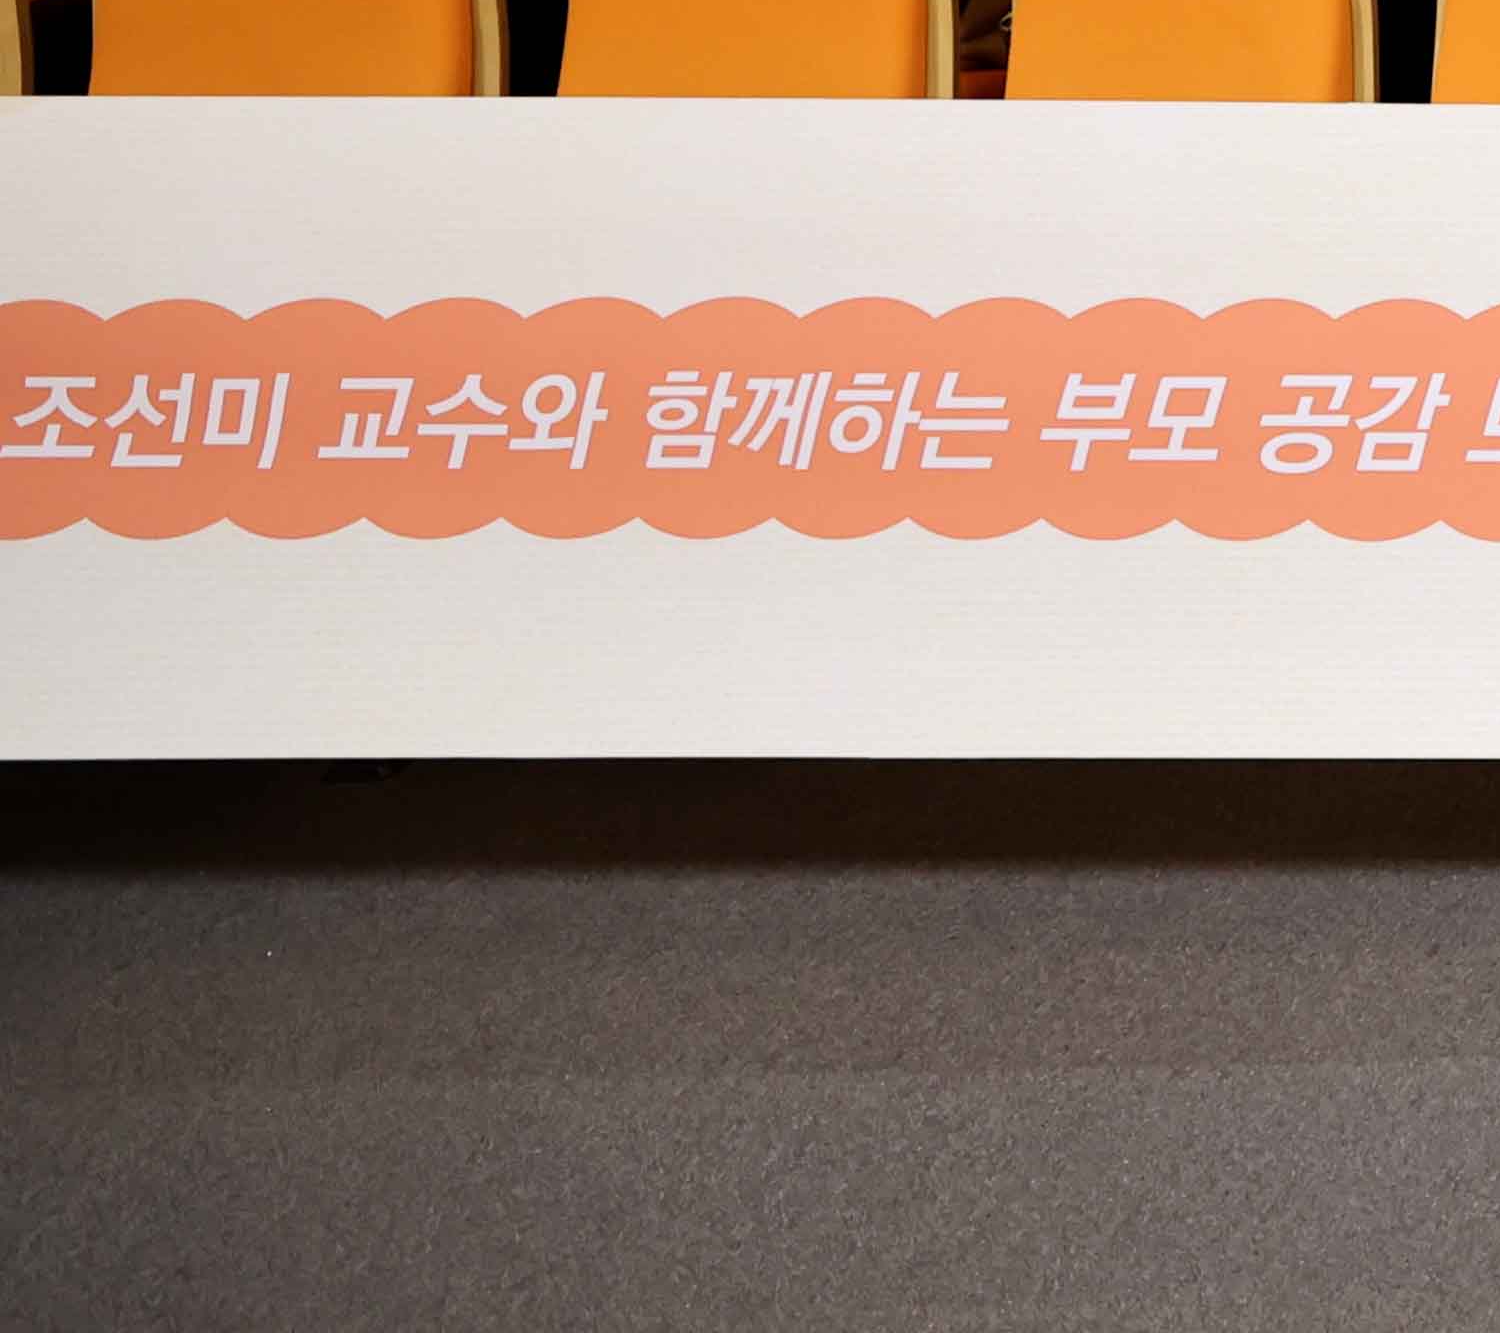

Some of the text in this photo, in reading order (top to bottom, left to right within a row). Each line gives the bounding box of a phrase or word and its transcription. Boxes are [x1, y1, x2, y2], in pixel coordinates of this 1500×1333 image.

[0, 373, 289, 469] 조선미
[319, 373, 607, 469] 교수와
[647, 372, 1009, 469] 함께하는
[1040, 374, 1226, 470] 부모
[1261, 373, 1450, 473] 공감
